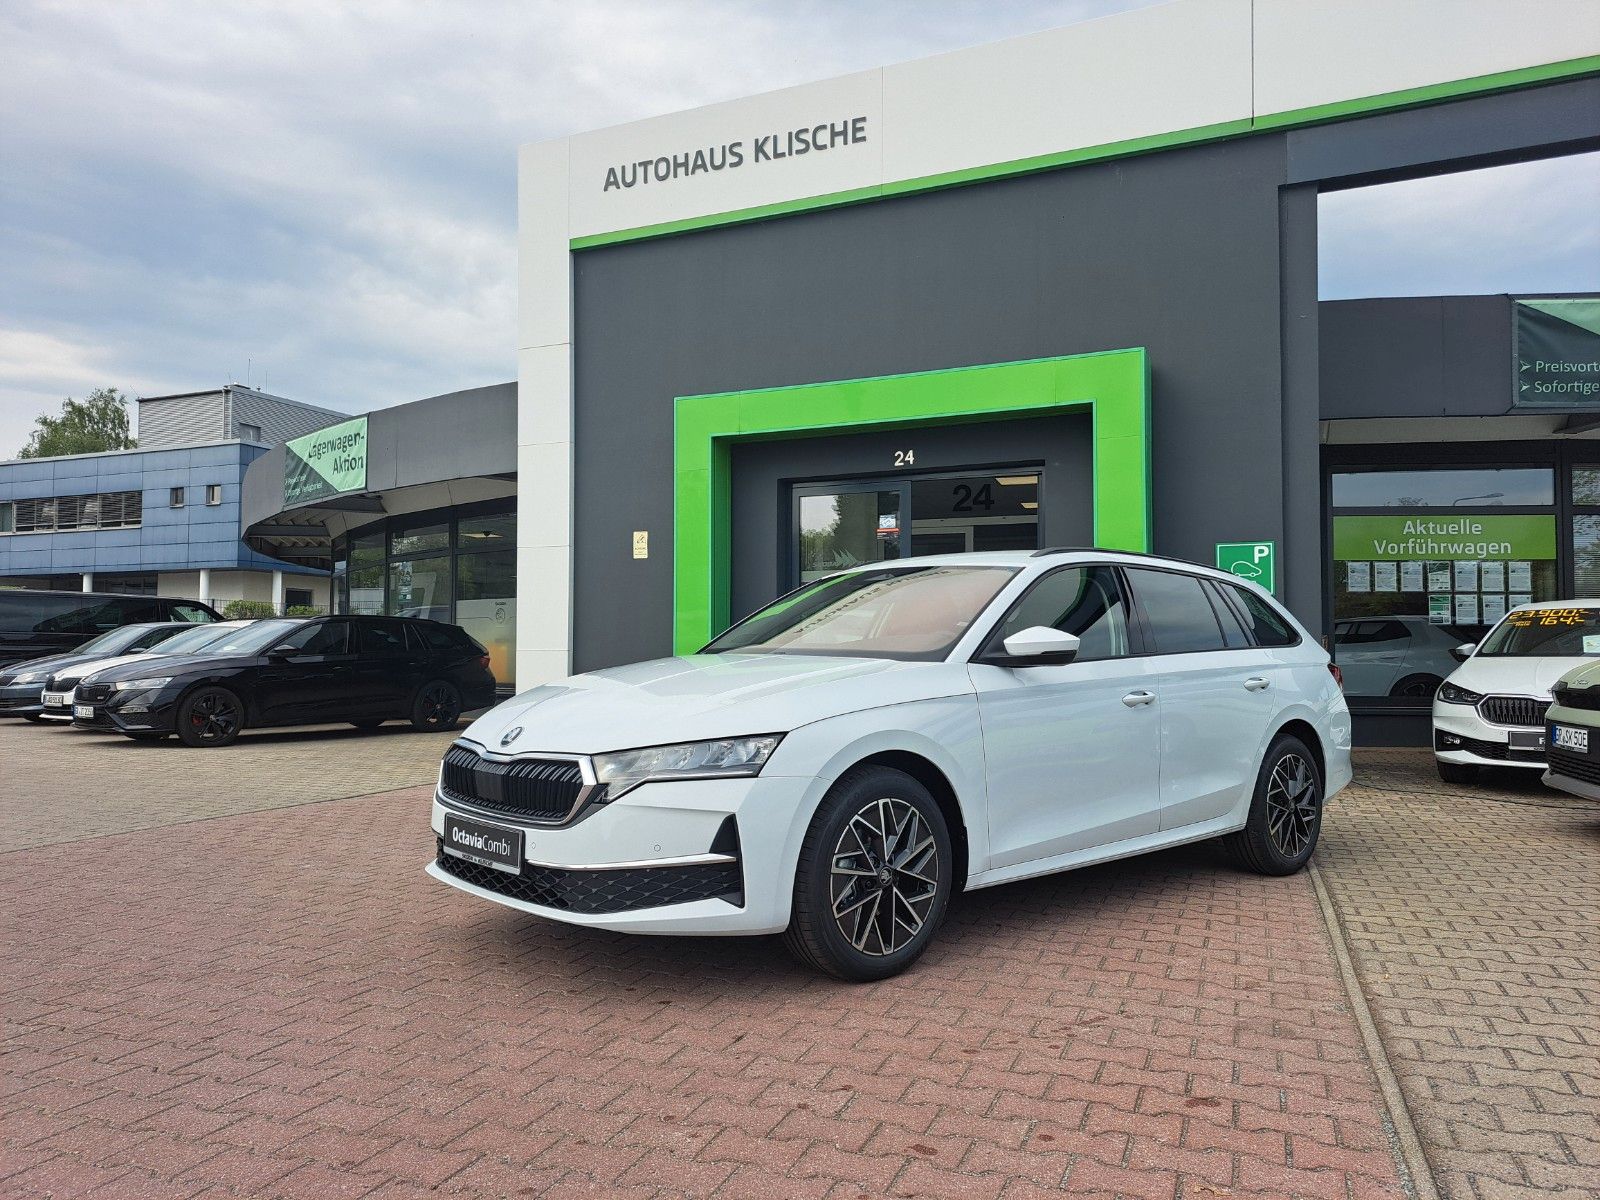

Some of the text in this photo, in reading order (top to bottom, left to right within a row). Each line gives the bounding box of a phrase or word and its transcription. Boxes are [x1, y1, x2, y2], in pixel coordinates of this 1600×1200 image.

[603, 116, 867, 192] AUTOHAUS KLISCHE
[1536, 360, 1600, 373] Preisvort
[1534, 380, 1600, 395] Sofortige
[308, 432, 365, 460] Lagerwagen-
[332, 453, 364, 475] Aktion
[894, 449, 915, 466] 24
[953, 484, 995, 511] 24
[1403, 519, 1482, 535] Aktuelle
[1253, 545, 1270, 564] P
[1373, 539, 1512, 558] Vorführwagen
[452, 826, 512, 857] OctaviaCombi
